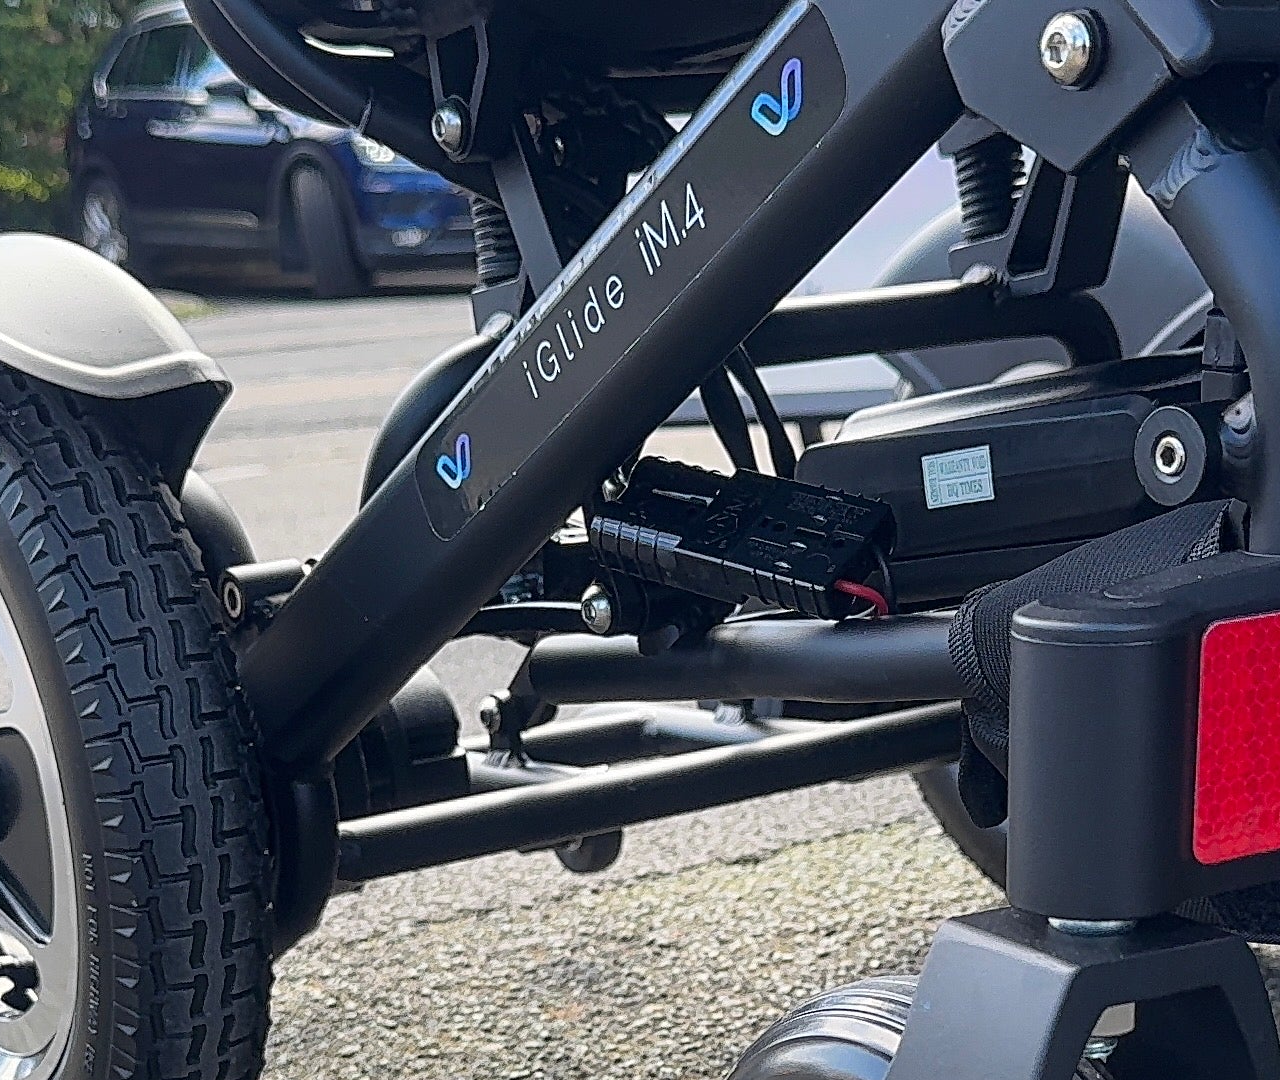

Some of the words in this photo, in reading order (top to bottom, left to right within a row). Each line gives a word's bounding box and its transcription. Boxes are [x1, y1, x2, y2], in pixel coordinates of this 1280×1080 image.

[523, 273, 626, 400] iGlide
[633, 182, 708, 275] iM.4
[86, 904, 99, 946] FOR
